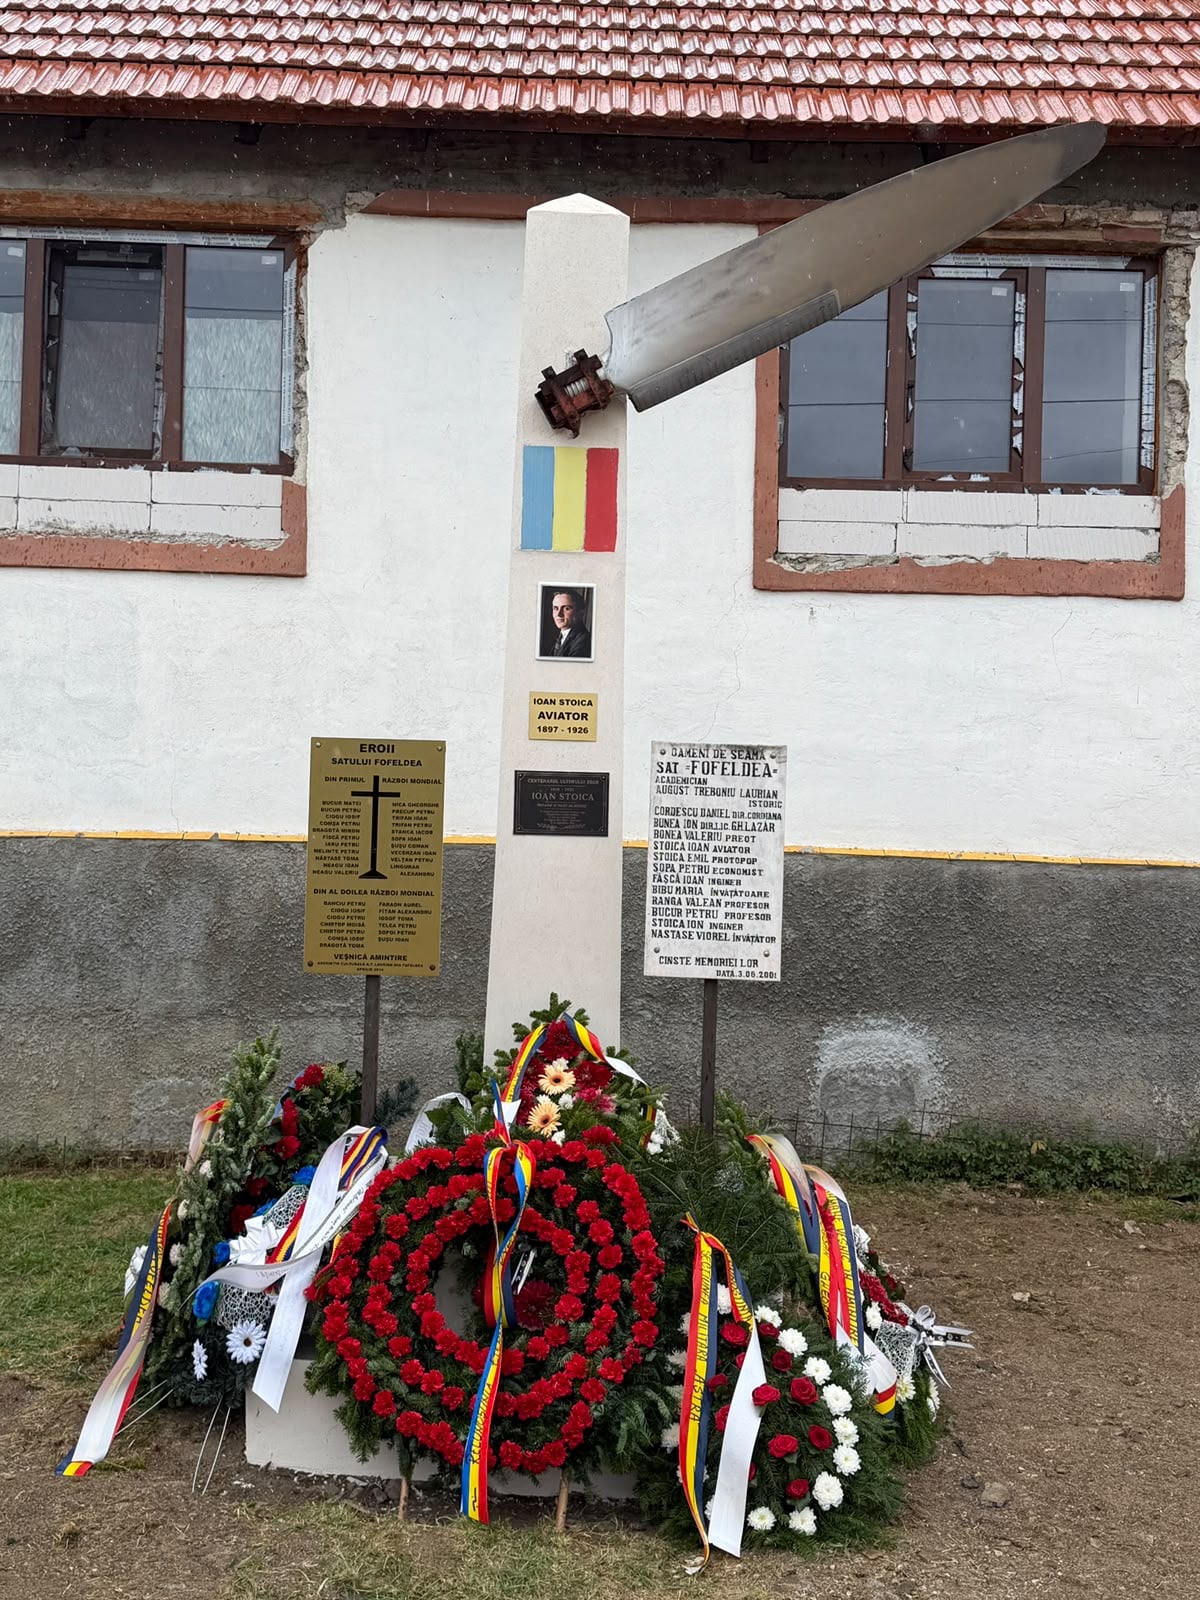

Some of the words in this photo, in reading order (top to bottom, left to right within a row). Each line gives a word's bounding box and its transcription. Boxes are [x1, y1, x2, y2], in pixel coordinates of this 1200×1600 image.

[538, 711, 588, 720] AVIATOR
[360, 744, 395, 753] EROII
[671, 748, 709, 758] OAMENI
[713, 749, 726, 759] DE
[656, 761, 679, 774] SAT
[655, 776, 708, 785] ACADEMICIAN
[656, 785, 689, 795] AUGUST
[694, 786, 736, 797] TREBONIU
[740, 788, 778, 799] LAURIAN
[748, 800, 782, 809] ISTORIC
[654, 806, 698, 818] CORDESCU
[700, 808, 730, 819] DANIEL
[654, 818, 680, 828] BUNEA
[683, 819, 698, 829] ION
[685, 830, 723, 841] VALERIU
[654, 841, 686, 851] STOICA
[688, 842, 710, 852] IOAN
[713, 845, 750, 854] AVIATOR
[653, 852, 684, 862] STOICA
[688, 854, 709, 863] EMIL
[712, 856, 758, 865] PROTOPOP
[653, 863, 676, 873] SOPA
[679, 864, 710, 874] PETRU
[712, 867, 764, 876] ECONOMIST
[683, 876, 704, 884] IOAN
[708, 878, 742, 886] INGINER
[652, 885, 673, 894] BIBU
[675, 887, 704, 896] MARIA
[652, 896, 682, 906] RANGA
[724, 901, 770, 909] PROFESOR
[652, 907, 682, 917] BUCUR
[686, 908, 718, 919] PETRU
[724, 912, 772, 920] PROFESOR
[652, 918, 685, 928] STOICA
[687, 920, 704, 928] ION
[709, 922, 743, 930] INGINER
[697, 931, 730, 941] VIOREL
[659, 956, 692, 966] CINSTE
[695, 957, 738, 968] MEMORIEI
[741, 959, 759, 968] LOR
